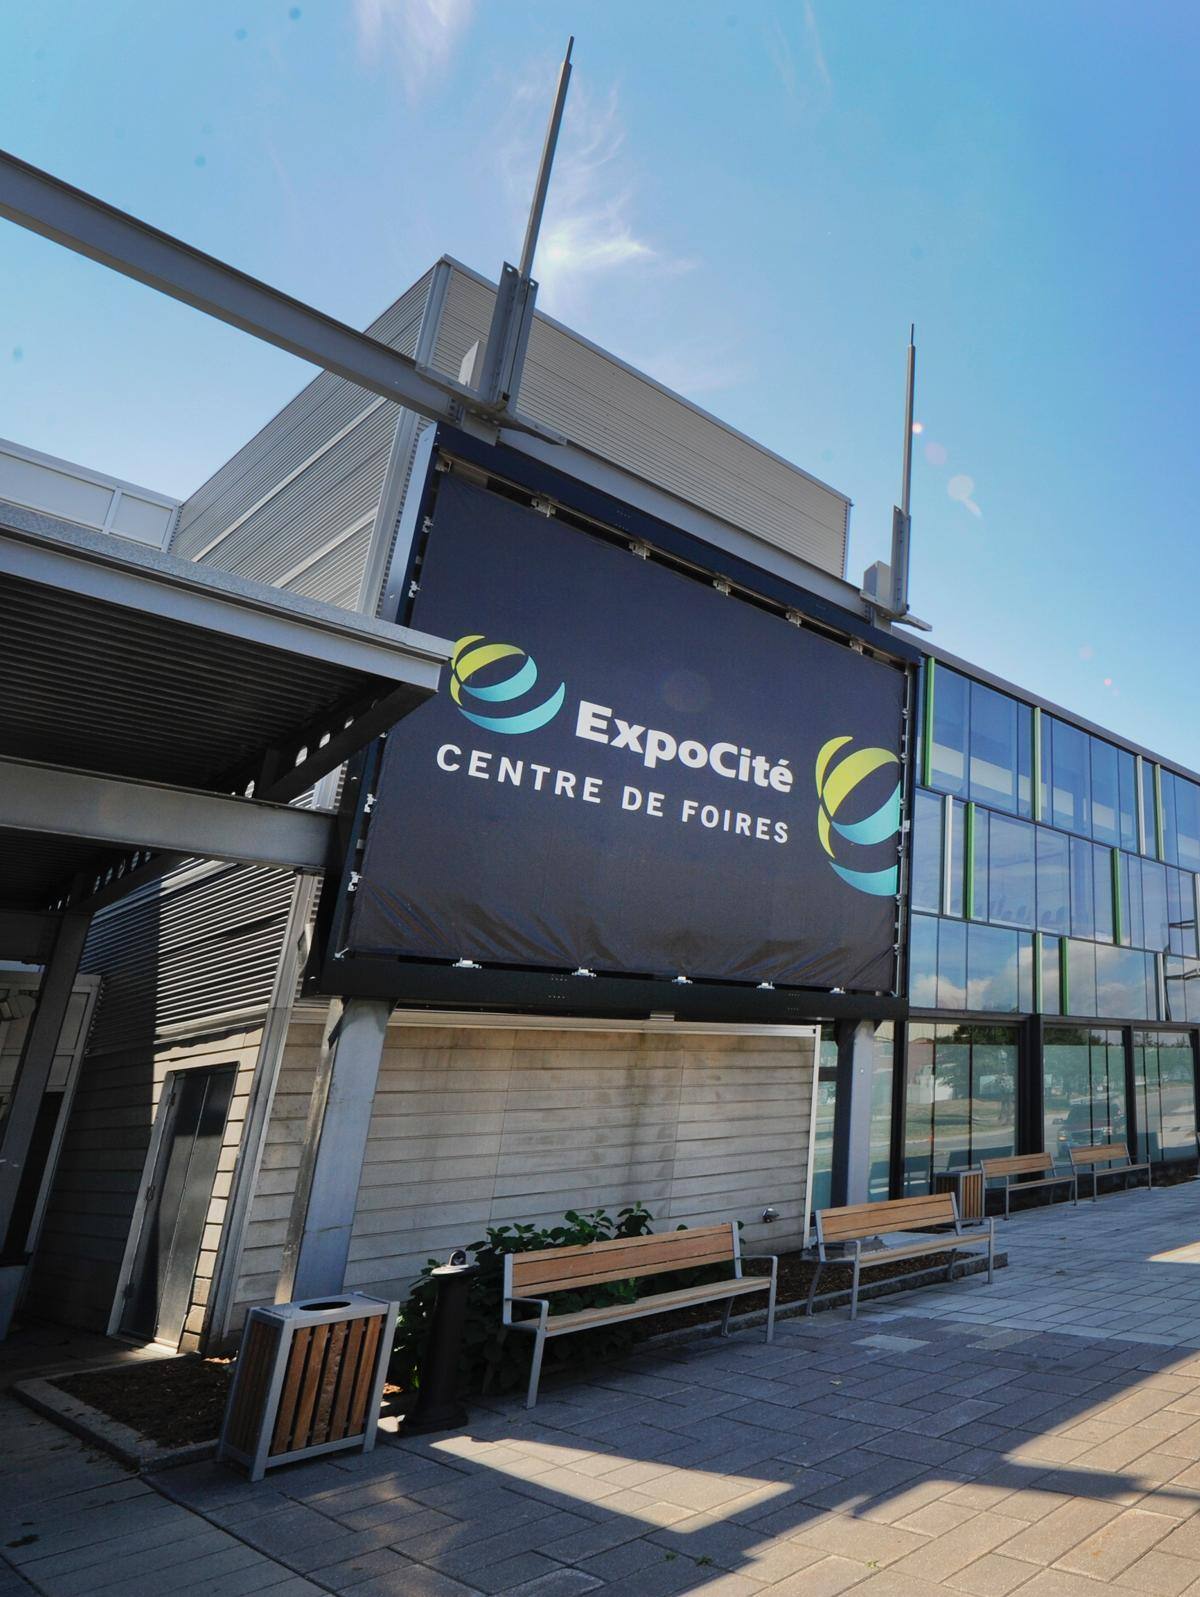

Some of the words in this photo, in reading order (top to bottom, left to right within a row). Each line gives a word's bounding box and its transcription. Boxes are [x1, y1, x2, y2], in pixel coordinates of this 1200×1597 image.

[436, 743, 603, 804] CENTRE
[621, 785, 665, 818] DE
[681, 799, 789, 844] FOIRES
[575, 700, 794, 793] ExpoCité
